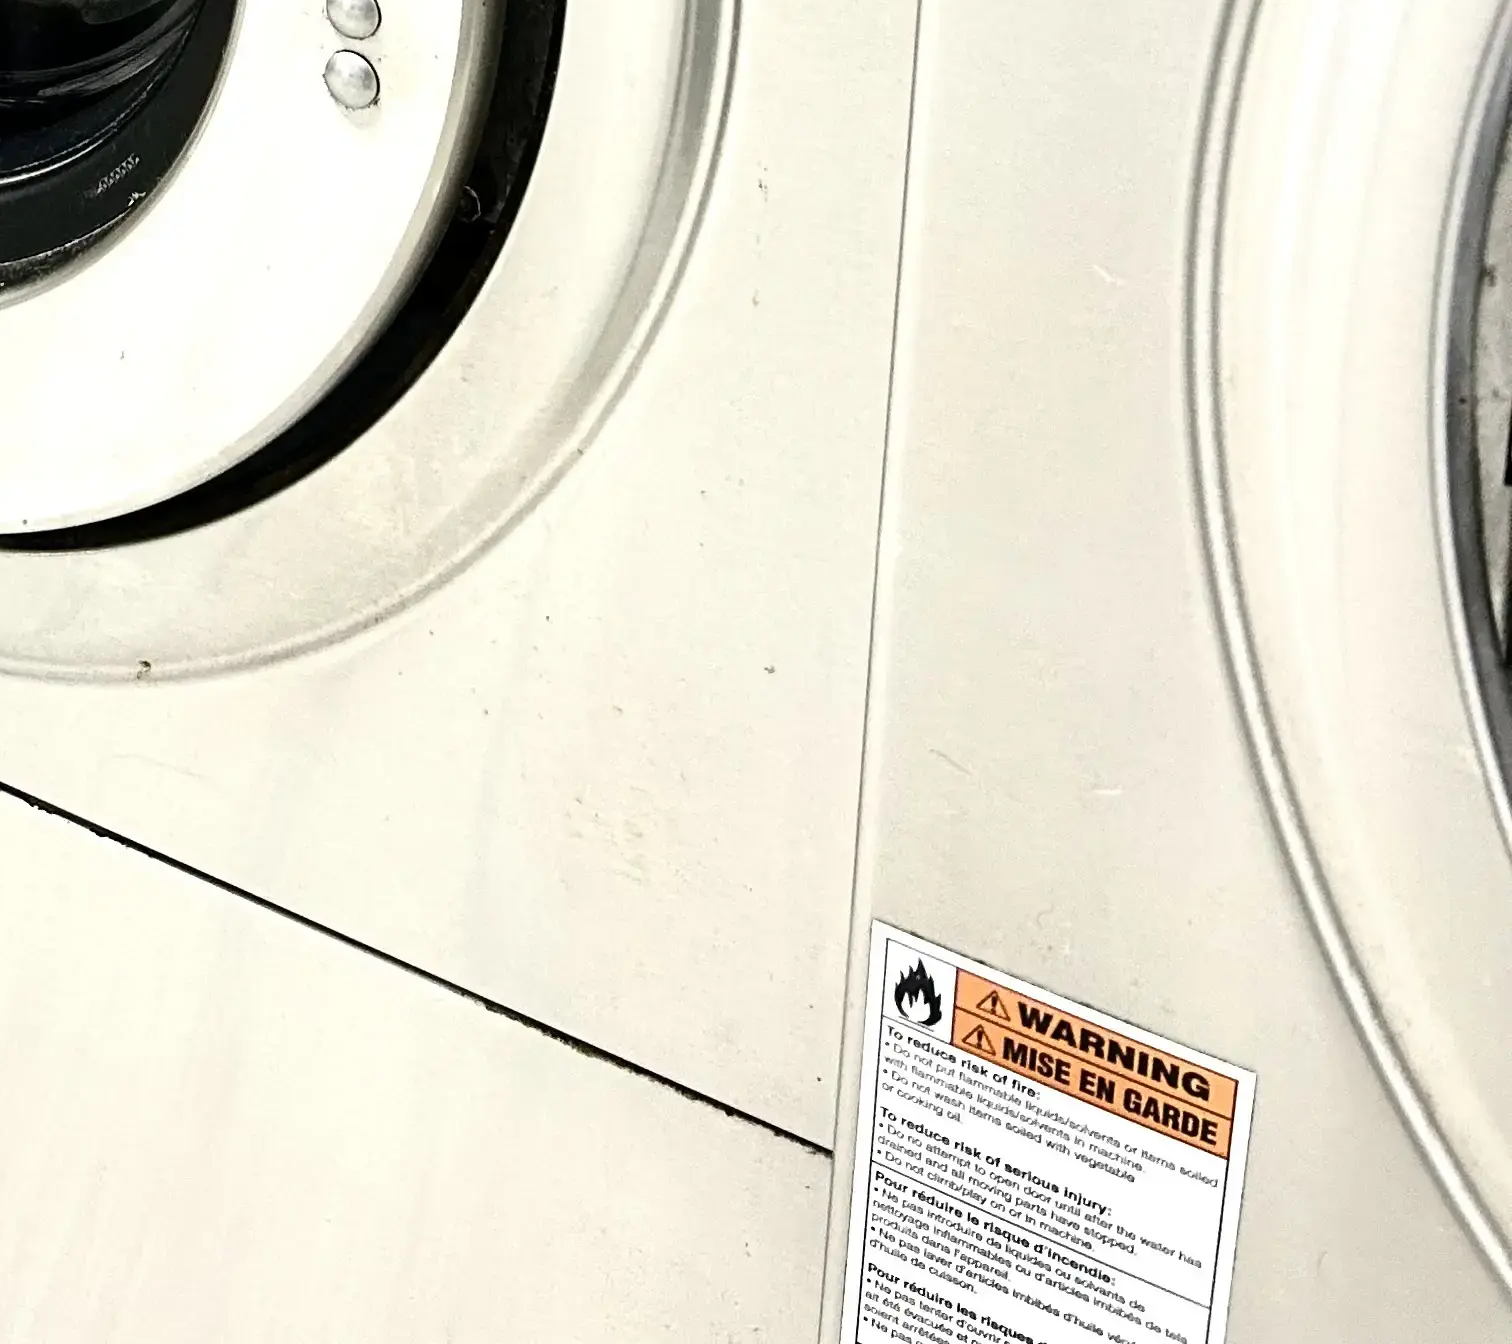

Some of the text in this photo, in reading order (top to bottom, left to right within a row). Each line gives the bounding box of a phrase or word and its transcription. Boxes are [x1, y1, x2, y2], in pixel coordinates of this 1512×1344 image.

[887, 1025, 903, 1040] To
[907, 1036, 956, 1063] reduce
[960, 1059, 988, 1077] risk
[992, 1073, 1007, 1085] of
[1002, 1037, 1217, 1145] MISE EN GARDE
[1018, 1002, 1209, 1099] WARNING
[880, 1106, 897, 1121] To
[900, 1117, 949, 1145] reduce
[954, 1141, 981, 1160] risk
[985, 1155, 1000, 1167] of
[1004, 1163, 1059, 1193] serious
[875, 1170, 908, 1192] Pour
[911, 1189, 962, 1218] réduire
[966, 1211, 979, 1225] le
[983, 1221, 1029, 1248] risque
